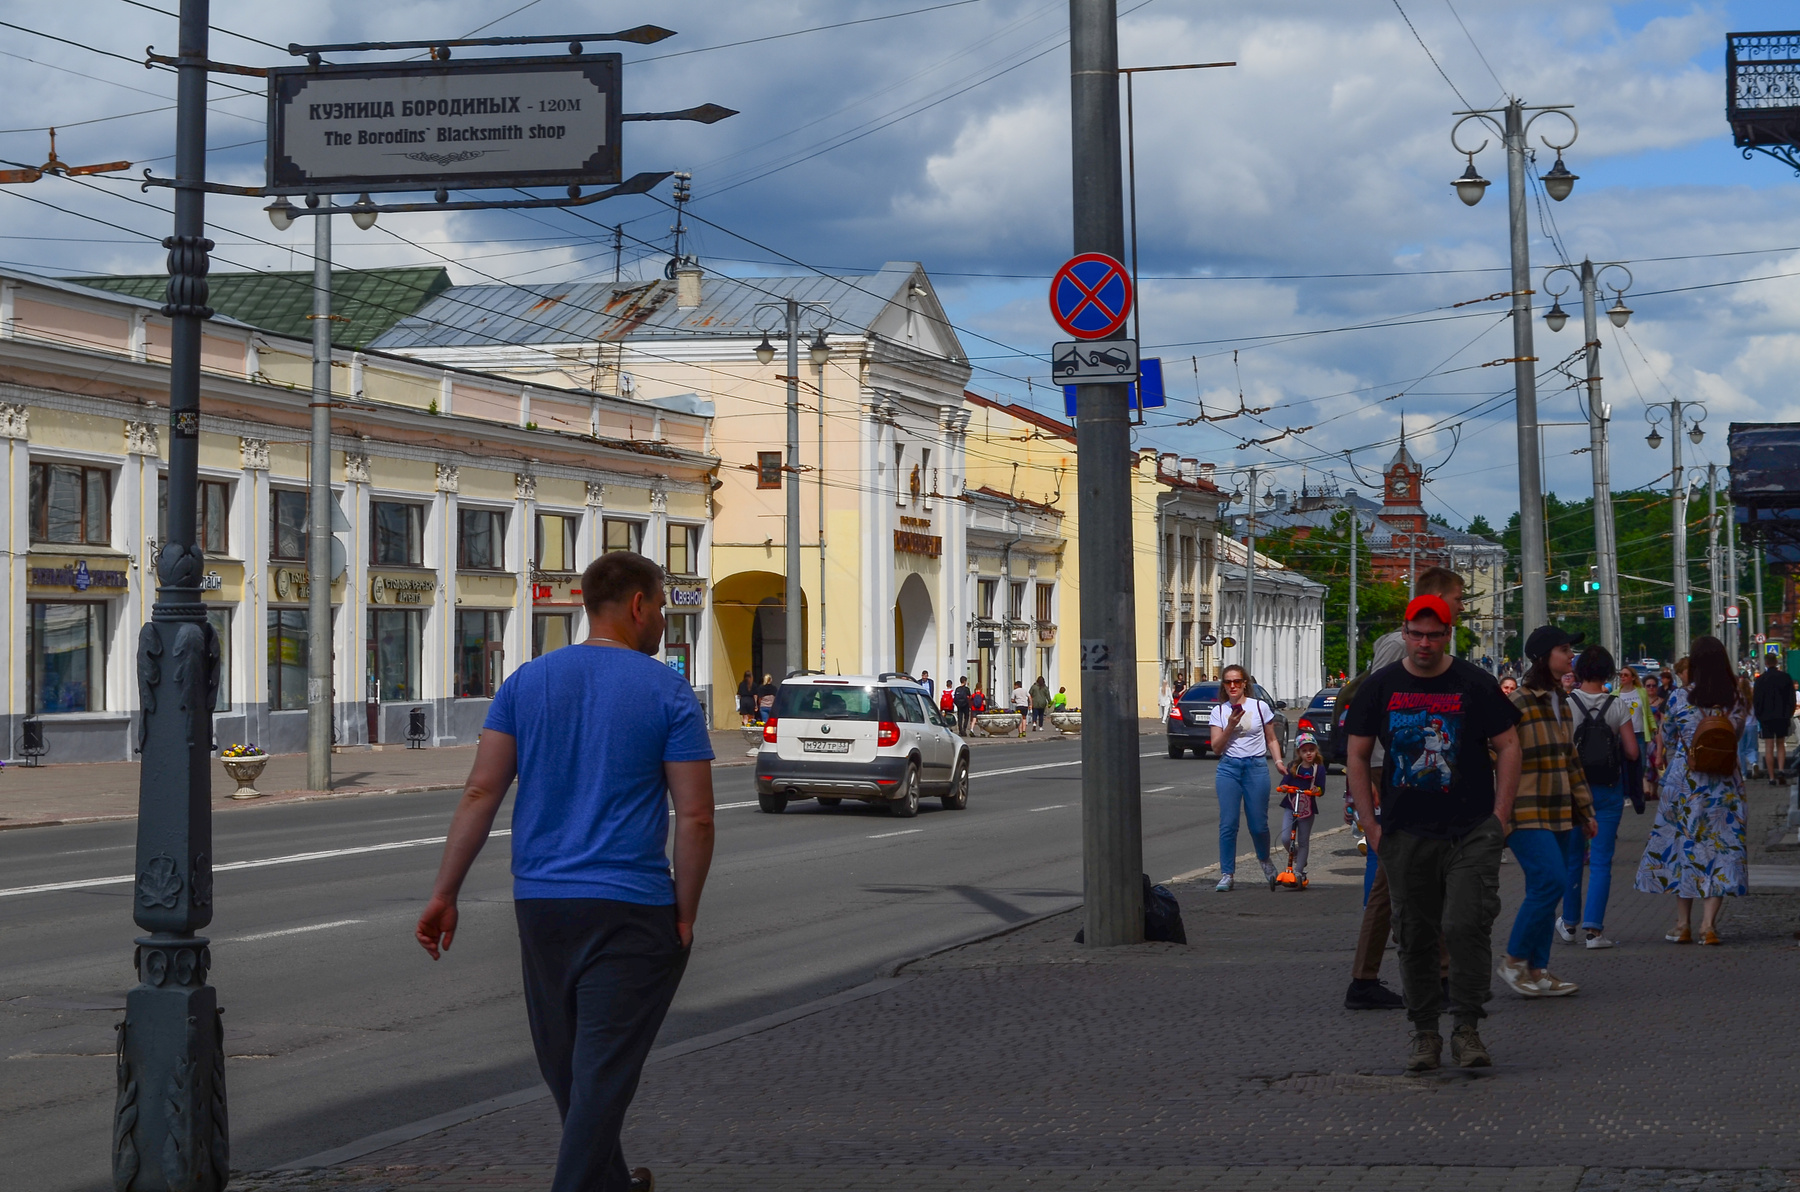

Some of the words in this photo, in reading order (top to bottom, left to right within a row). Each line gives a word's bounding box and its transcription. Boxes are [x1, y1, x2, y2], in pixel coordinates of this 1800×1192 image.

[309, 101, 395, 120] КУЗНИЦА
[401, 96, 521, 117] БОРОДИНЫХ
[539, 99, 581, 112] 120М
[324, 131, 352, 146] The
[437, 124, 523, 142] Blacksmith
[528, 123, 566, 140] shop
